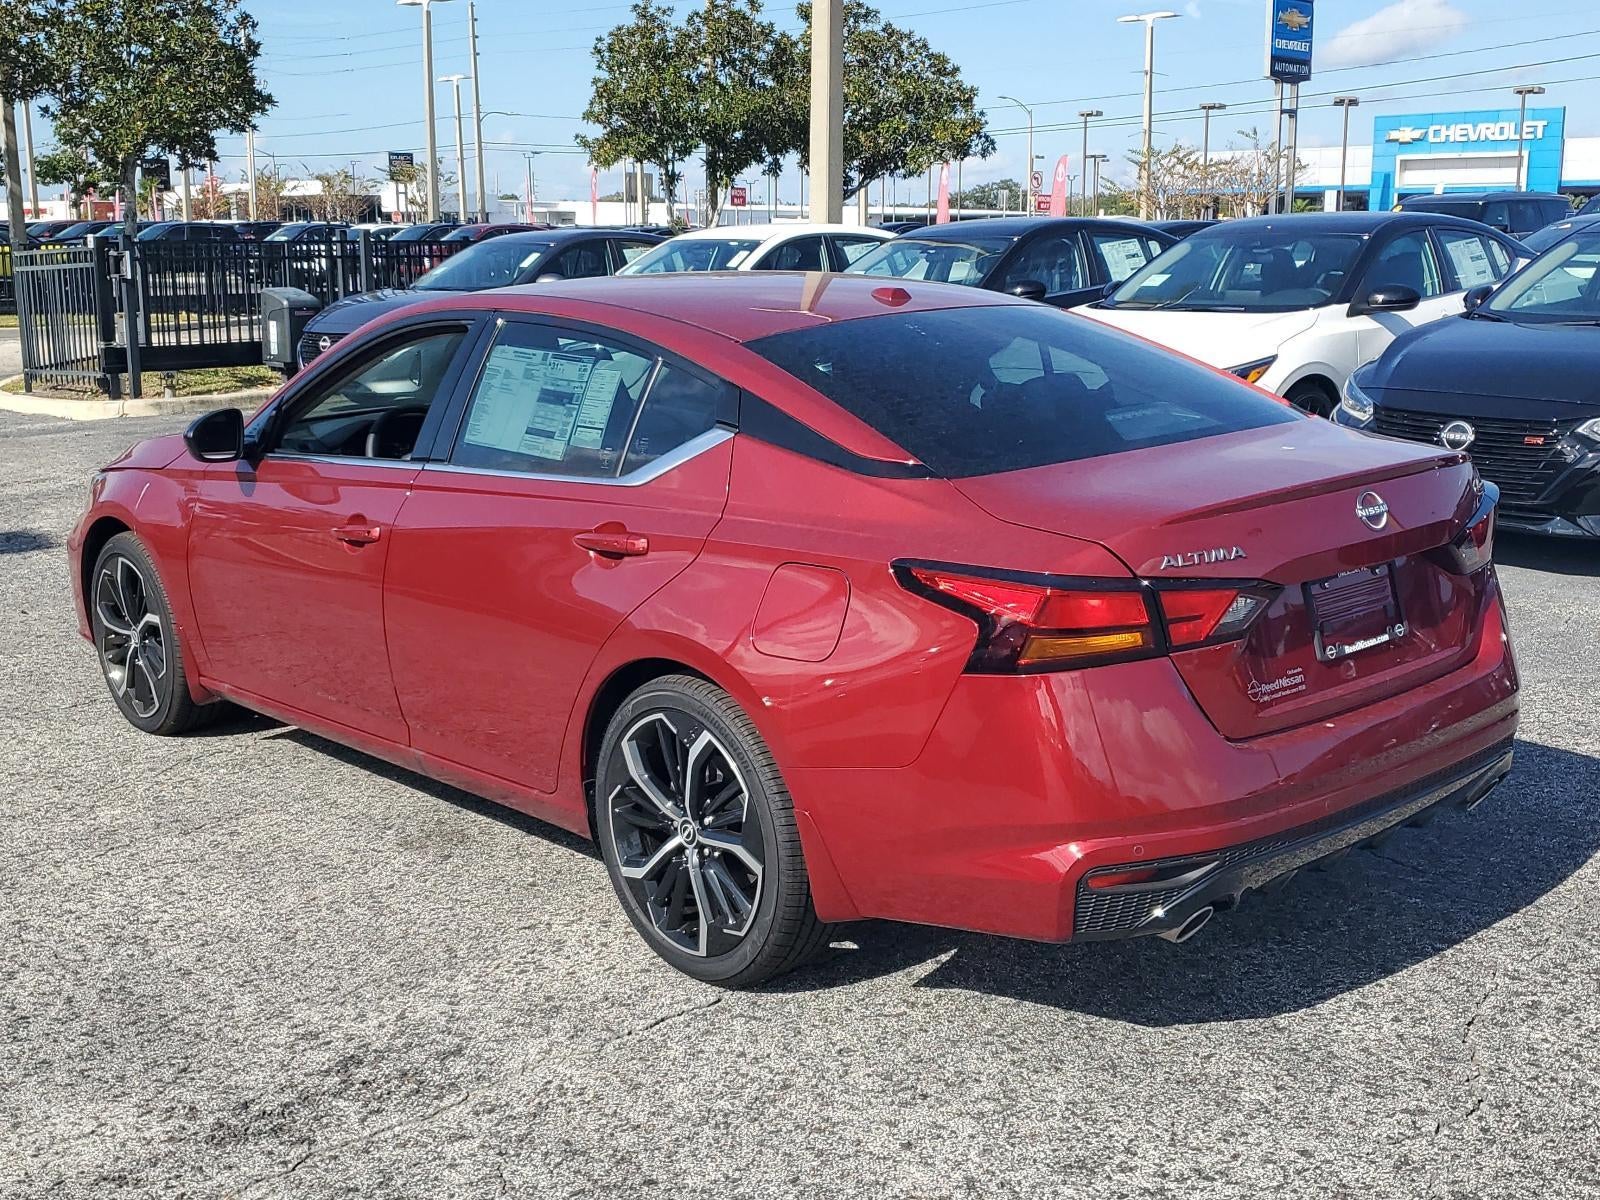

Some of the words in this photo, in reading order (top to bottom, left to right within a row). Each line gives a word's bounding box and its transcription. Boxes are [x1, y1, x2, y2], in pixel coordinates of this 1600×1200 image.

[1275, 39, 1310, 52] CHEVROLET
[1274, 62, 1309, 74] AUTONATION
[1428, 120, 1548, 144] CHEVROLET
[1441, 432, 1475, 442] NISSAN
[1357, 503, 1389, 517] NISSAN
[1160, 546, 1246, 570] ALTIMA
